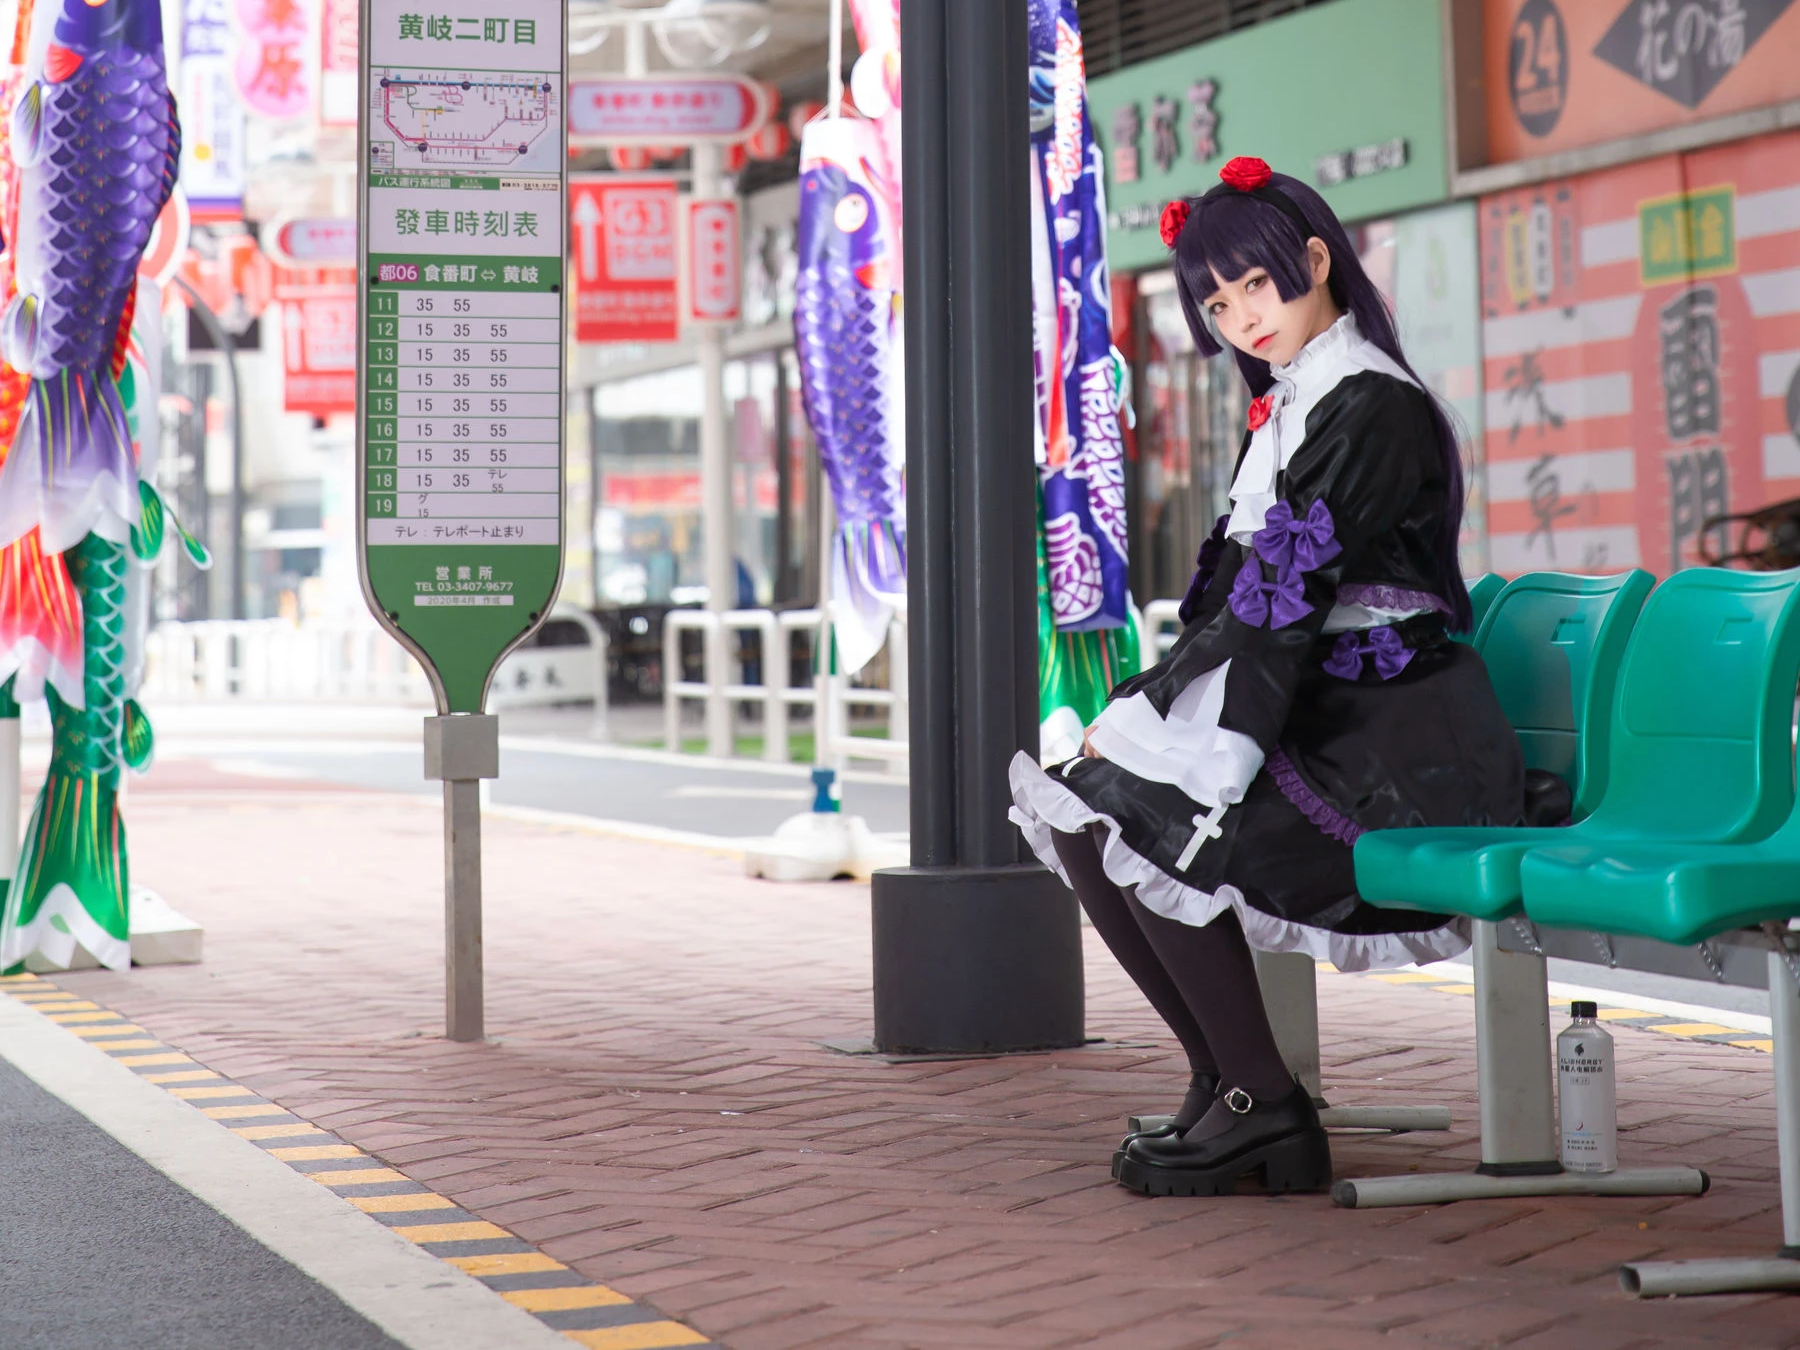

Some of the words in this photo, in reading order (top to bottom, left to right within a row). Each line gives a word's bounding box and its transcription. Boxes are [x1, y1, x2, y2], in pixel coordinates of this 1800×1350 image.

[398, 13, 536, 45] 黄岐二町目
[395, 208, 539, 238] 發車時刻表
[379, 264, 418, 281] 都06
[378, 297, 392, 311] 11
[417, 298, 433, 311] 35
[454, 299, 470, 312] 55
[378, 322, 393, 336] 12
[418, 323, 433, 336] 15
[454, 324, 470, 336] 35
[491, 324, 507, 337] 55
[378, 348, 393, 361] 13
[418, 348, 432, 361] 15
[454, 349, 470, 361] 35
[491, 349, 507, 362] 55
[378, 373, 392, 386] 14
[418, 373, 432, 386] 15
[453, 374, 470, 386] 35
[491, 374, 507, 387] 55
[377, 398, 392, 411] 15
[418, 399, 432, 411] 15
[453, 399, 469, 411] 35
[491, 399, 507, 412] 55
[377, 423, 392, 436] 16
[418, 424, 432, 436] 15
[453, 424, 469, 436] 35
[490, 424, 506, 437] 55
[376, 449, 393, 462] 17
[417, 449, 432, 462] 15
[453, 449, 469, 462] 35
[490, 449, 506, 462] 55
[376, 474, 393, 487] 18
[417, 474, 432, 487] 15
[453, 474, 469, 487] 35
[376, 499, 393, 512] 19
[416, 581, 434, 591] TEL
